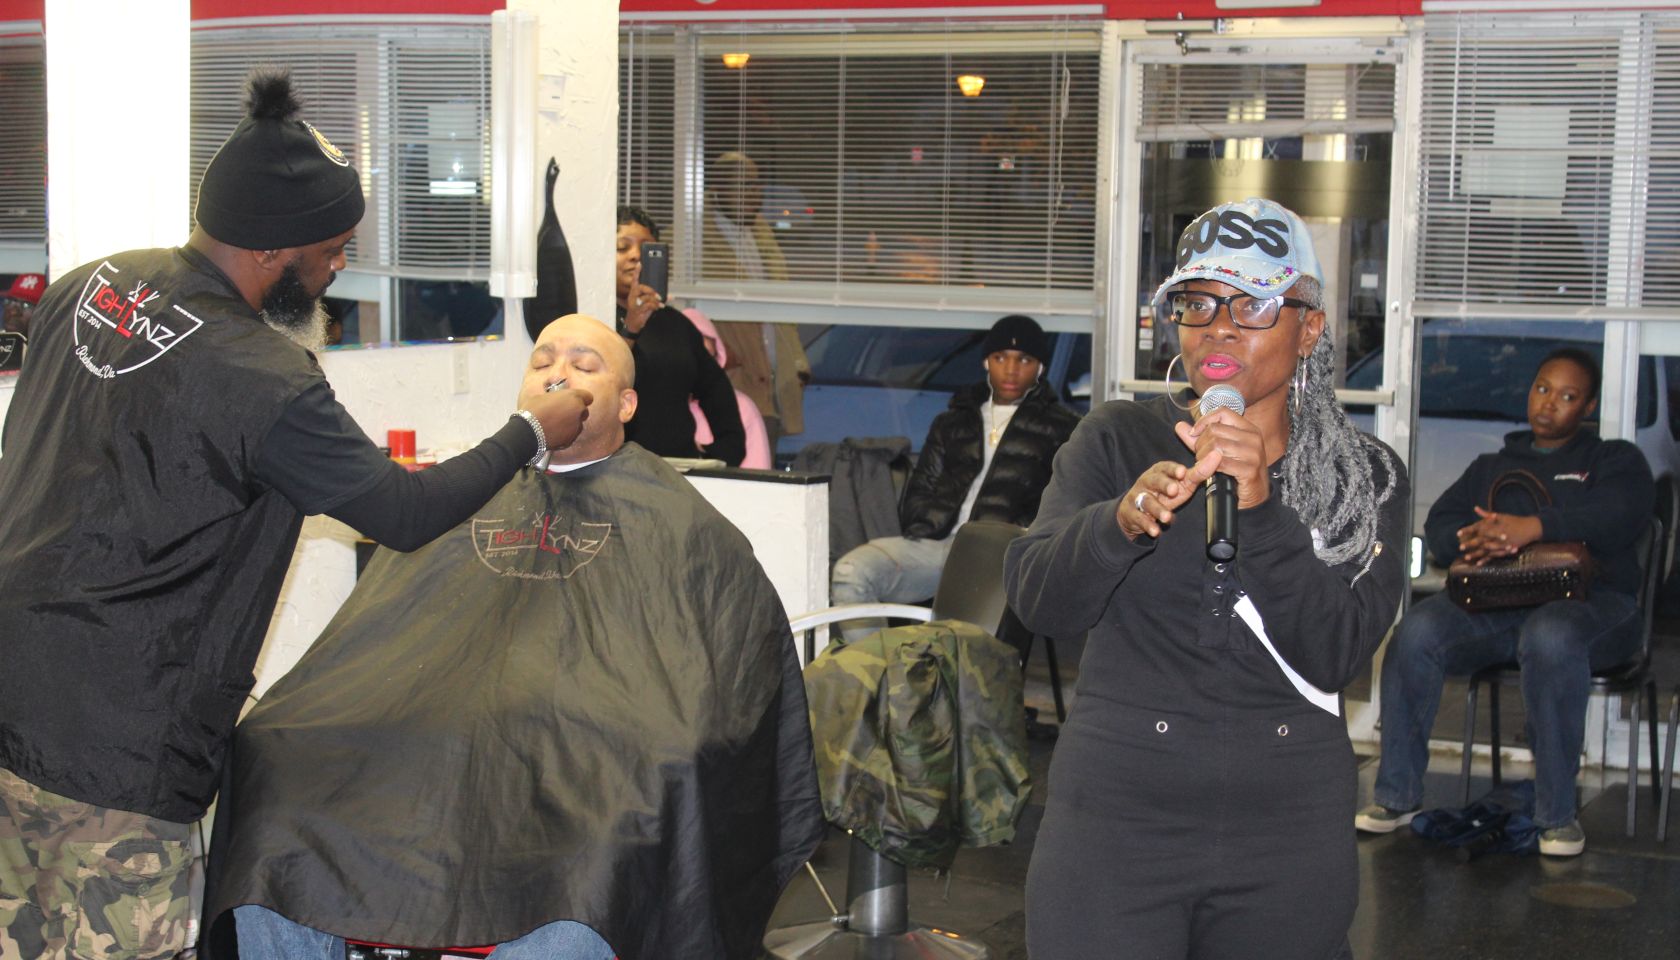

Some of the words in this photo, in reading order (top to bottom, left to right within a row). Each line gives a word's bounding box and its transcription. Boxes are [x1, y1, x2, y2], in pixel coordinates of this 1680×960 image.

[1176, 210, 1289, 270] BOSS
[78, 309, 90, 320] EST
[87, 316, 102, 330] 2014
